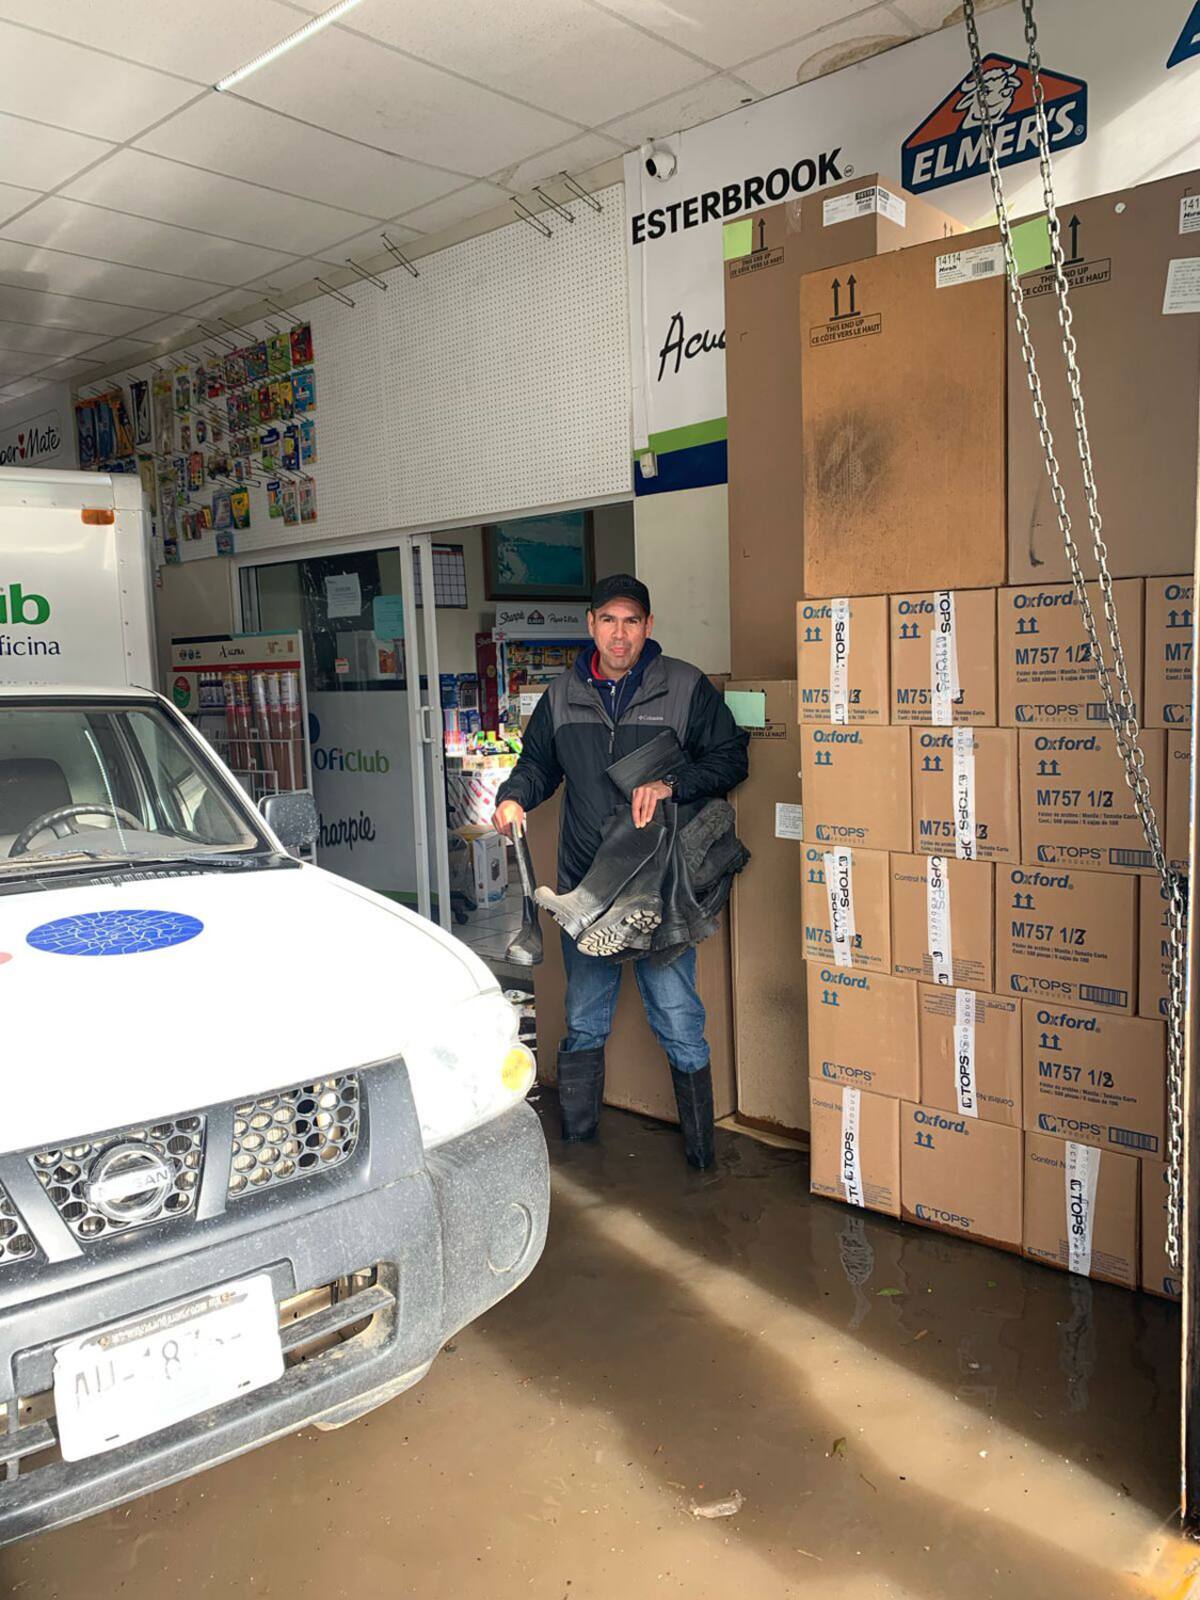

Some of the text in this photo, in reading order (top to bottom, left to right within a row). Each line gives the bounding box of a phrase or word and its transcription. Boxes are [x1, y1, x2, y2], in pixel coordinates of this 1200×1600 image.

[912, 101, 1077, 186] ELMER'S
[632, 147, 842, 245] ESTERBROOK
[939, 253, 961, 266] 14114
[1075, 277, 1085, 285] LE
[1086, 271, 1109, 282] HAUT
[1077, 267, 1089, 276] UP
[811, 336, 820, 344] CE
[836, 328, 853, 338] VERS
[854, 327, 861, 335] LE
[862, 323, 880, 333] HAUT
[826, 319, 865, 333] THIS END UP
[26, 428, 61, 459] Mate
[1013, 591, 1074, 609] Oxford
[835, 621, 846, 664] TOPS
[1016, 647, 1059, 665] M757
[1034, 704, 1079, 716] TOPS
[813, 730, 859, 744] Oxford
[1034, 736, 1096, 751] Oxford
[313, 747, 390, 774] OfiClub
[1037, 790, 1081, 807] M757
[958, 788, 969, 831] TOPS
[316, 810, 376, 851] harpie
[831, 825, 865, 837] TOPS
[1056, 846, 1101, 860] TOPS
[894, 872, 919, 882] Control
[931, 856, 942, 889] OPS
[1010, 870, 1069, 889] Oxford
[838, 869, 850, 909] TOPS
[806, 927, 832, 944] M75
[1012, 922, 1054, 941] M757
[820, 969, 867, 989] Oxford
[1029, 977, 1073, 994] TOPS
[1037, 1010, 1096, 1031] Oxford
[838, 1064, 873, 1081] TOPS
[959, 1054, 972, 1096] TOPS
[1039, 1061, 1082, 1083] M757
[812, 1098, 832, 1110] Control
[913, 1110, 965, 1134] Oxford
[1056, 1116, 1101, 1136] TOPS
[844, 1131, 855, 1171] TOPS
[1031, 1152, 1059, 1168] Control
[932, 1209, 971, 1228] TOPS
[1071, 1193, 1084, 1236] TOPS
